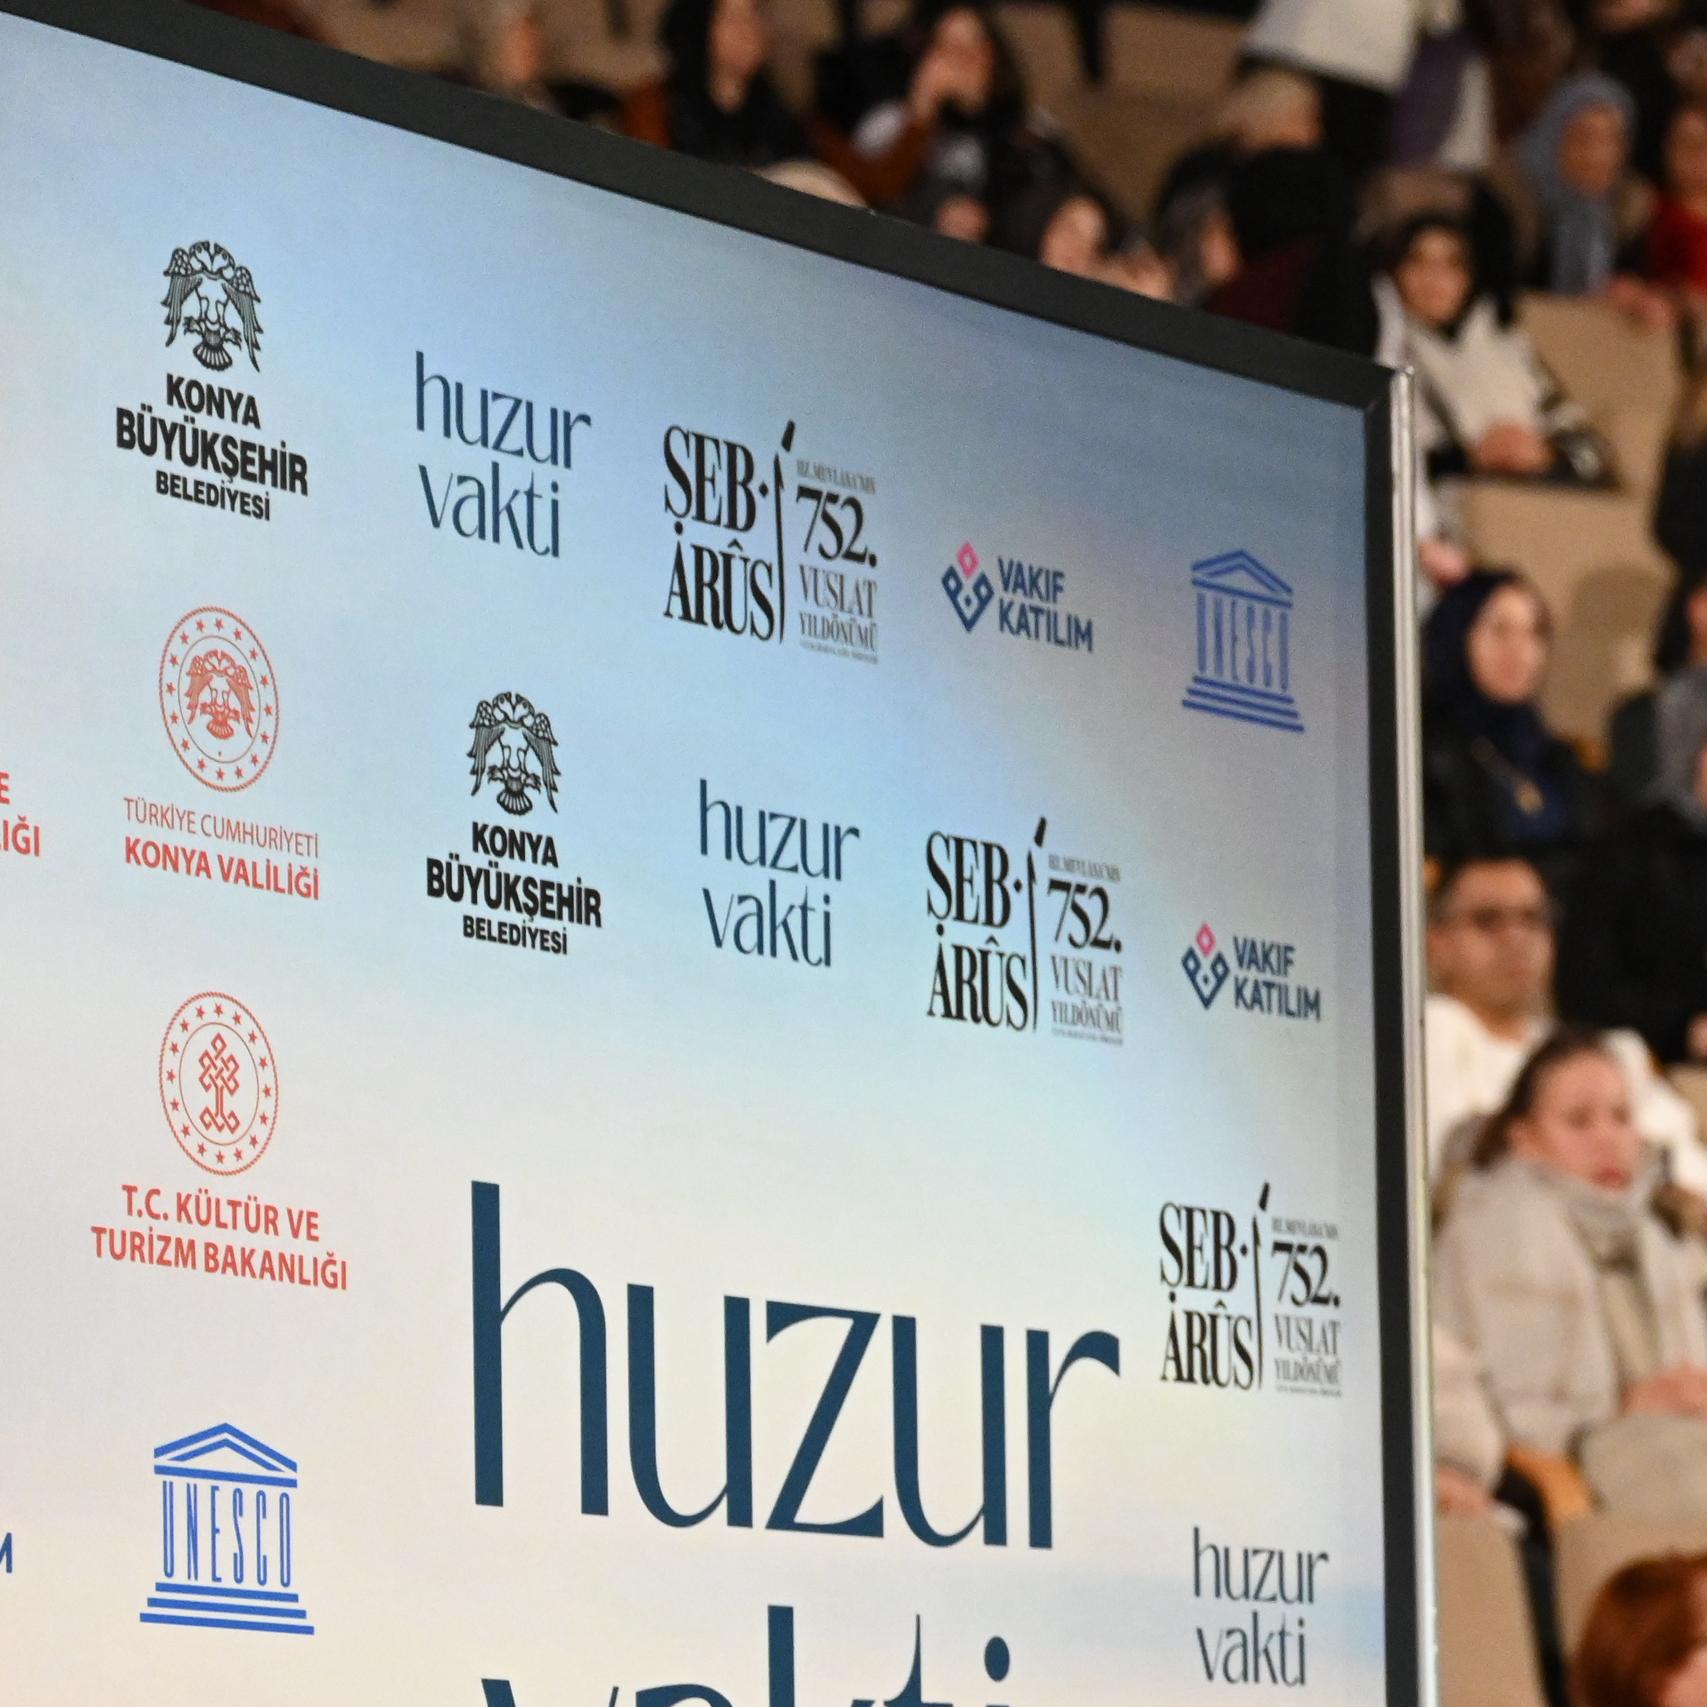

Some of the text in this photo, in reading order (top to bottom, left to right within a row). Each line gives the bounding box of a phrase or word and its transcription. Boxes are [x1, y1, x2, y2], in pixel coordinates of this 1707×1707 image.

[166, 372, 261, 429] KONYA
[414, 350, 592, 470] huzur
[115, 403, 309, 497] BÜYÜKŞEHİR
[155, 469, 271, 521] BELEDİYESİ
[418, 461, 561, 558] vakti
[796, 484, 878, 568] 752.
[663, 538, 775, 642] ARÛS
[800, 564, 877, 619] VUSLAT
[999, 558, 1065, 599] VAKIF
[1000, 598, 1093, 653] KATILIM
[124, 797, 320, 859] TÜRKİYE CUMHURİYETİ
[471, 821, 558, 868] KONYA
[700, 778, 860, 883] huzur
[124, 836, 320, 901] KONYA VALİLİĞİ
[426, 855, 602, 929] BÜYÜKŞEHİR
[462, 915, 567, 955] BELEDİYESİ
[702, 879, 832, 968] vakti
[1047, 877, 1122, 953] 752.
[927, 935, 1028, 1032] ARÛS
[1051, 955, 1122, 1003] VUSLAT
[1233, 936, 1295, 977] VAKIF
[1234, 975, 1321, 1023] KATILIM
[121, 1184, 320, 1243] T.C. KÜLTÜR VE
[91, 1226, 348, 1291] TURİZM BAKANLIĞI
[1271, 1240, 1341, 1308] 752.
[471, 1180, 1121, 1550] huzur
[1160, 1299, 1254, 1391] ARÛS
[162, 1479, 291, 1589] UNESCO
[1194, 1525, 1330, 1606] huzur
[1197, 1609, 1307, 1688] vakti
